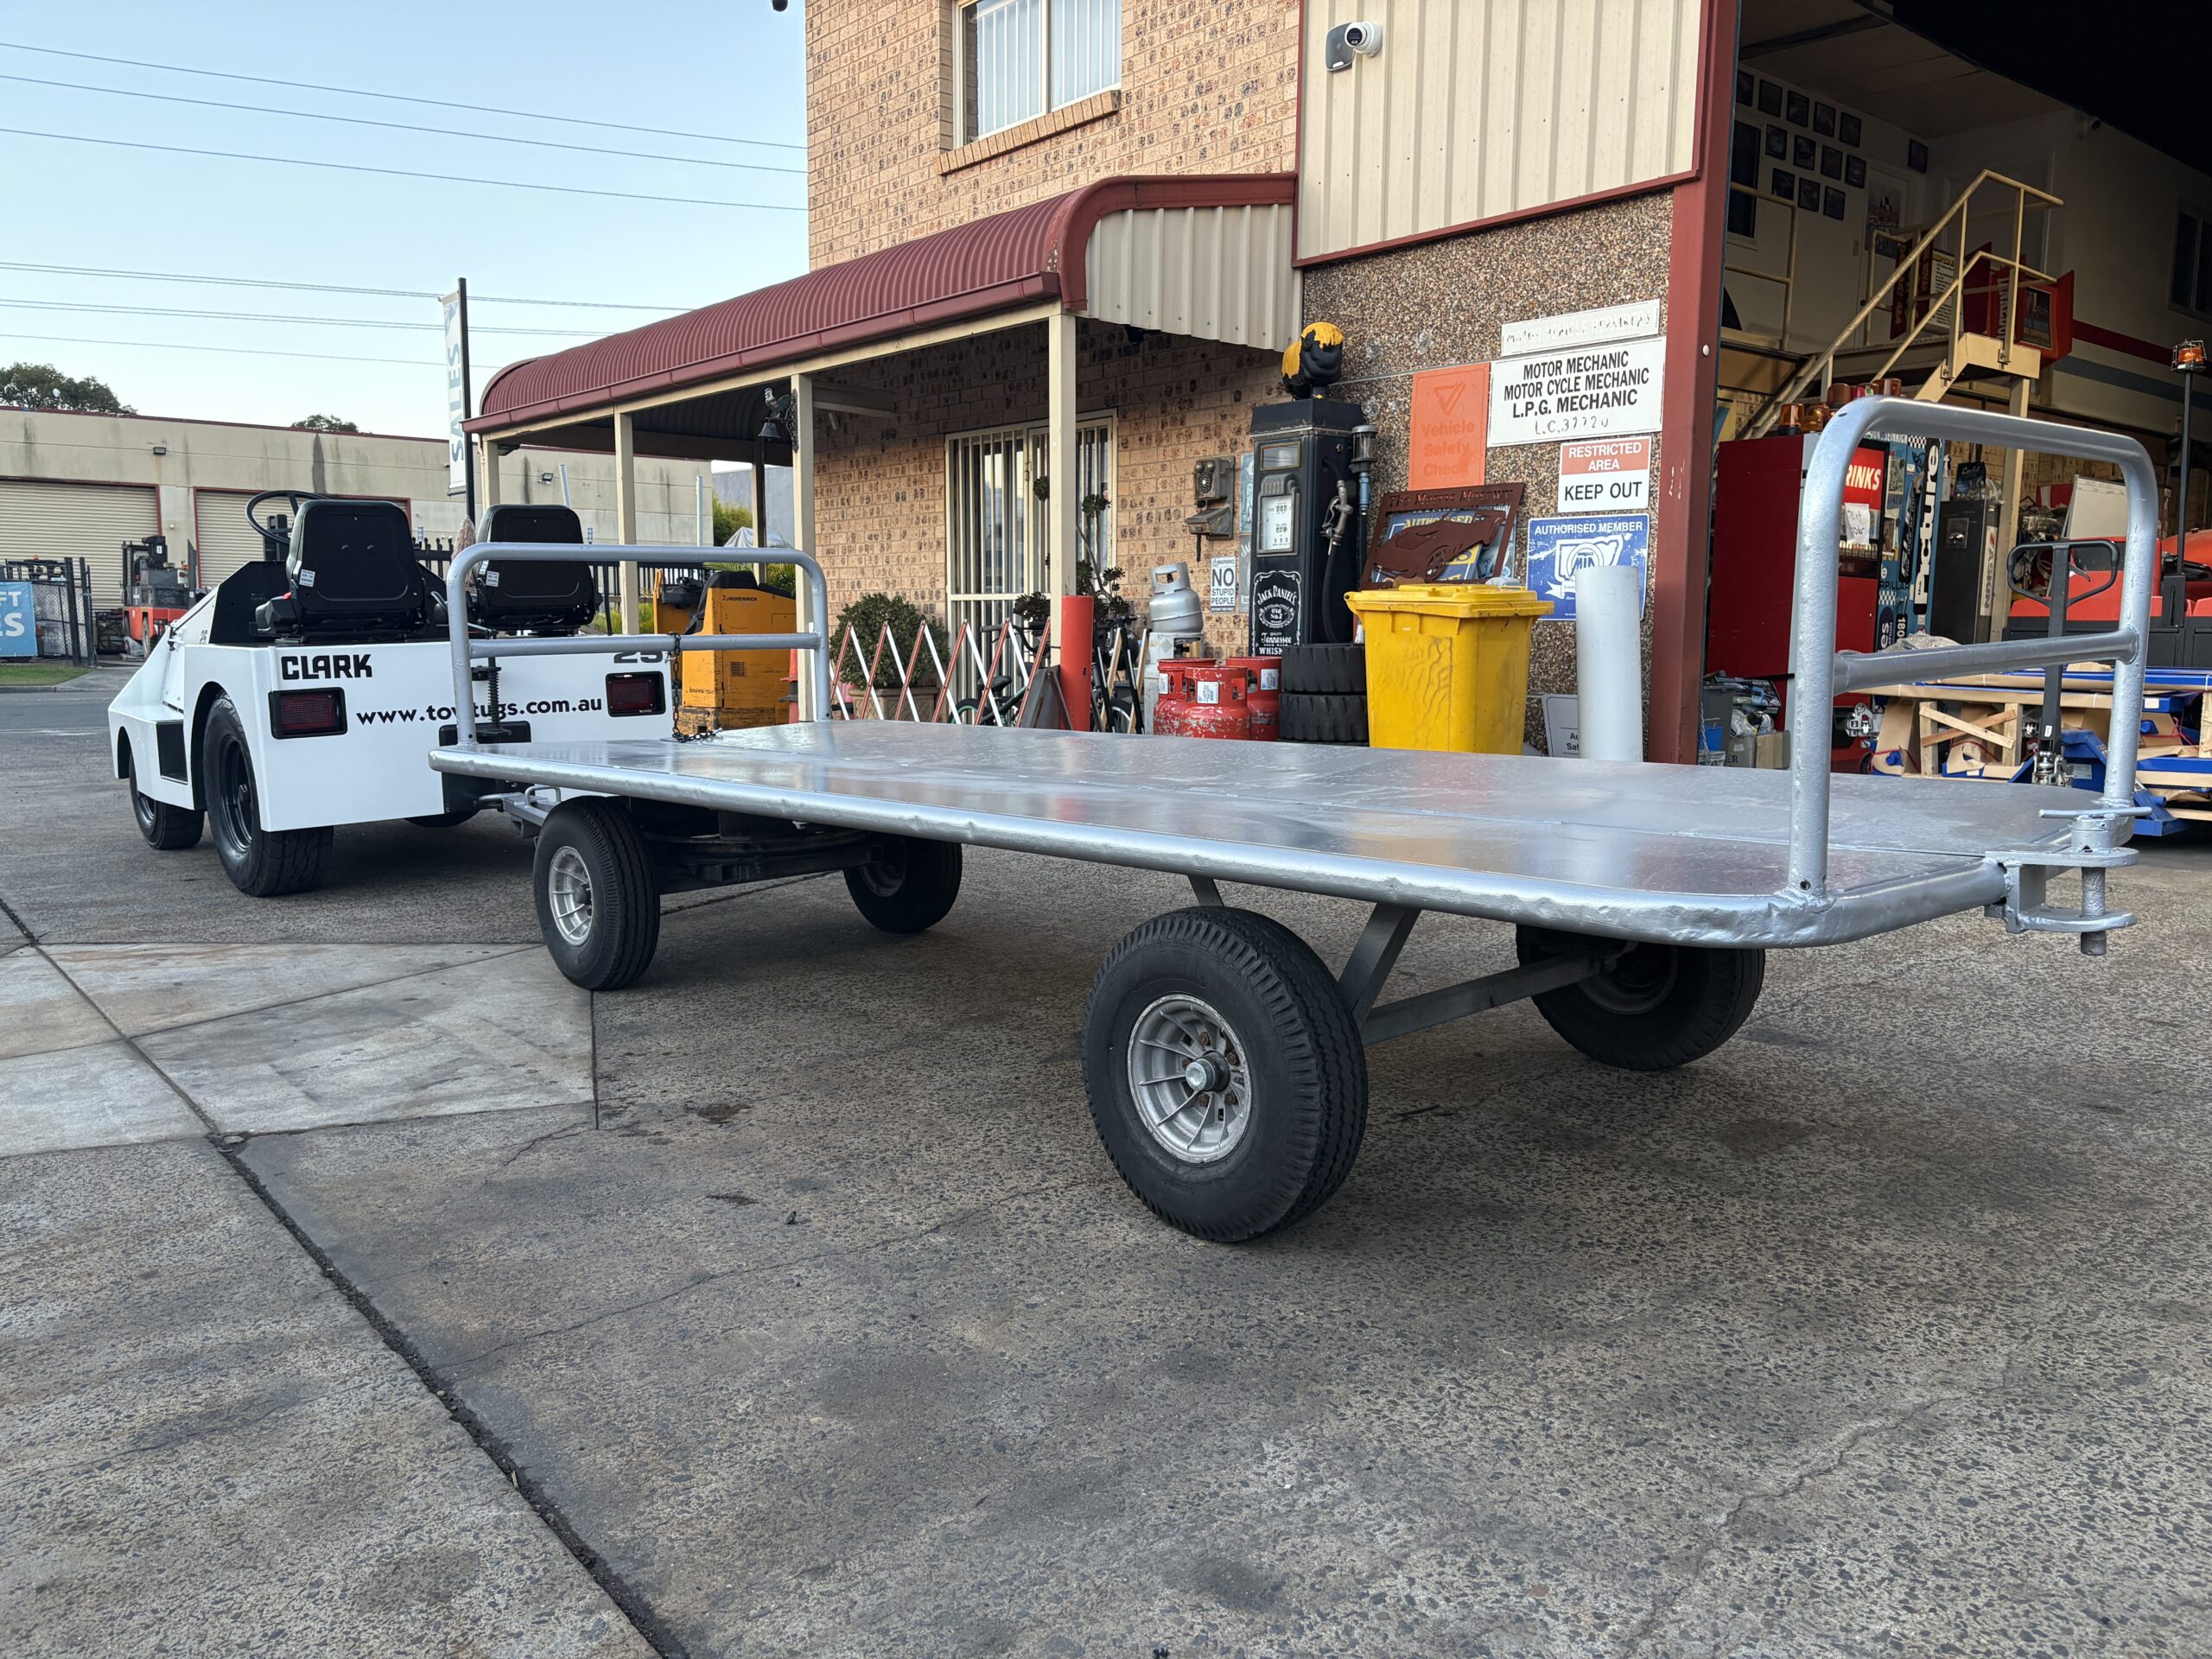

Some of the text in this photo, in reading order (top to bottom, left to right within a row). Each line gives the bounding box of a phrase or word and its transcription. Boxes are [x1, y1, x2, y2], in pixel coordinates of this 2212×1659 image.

[1523, 351, 1629, 380] MOTOR MECHANIC
[1504, 367, 1649, 401] MOTOR CYCLE MECHANIC
[447, 342, 464, 463] SALES
[1513, 389, 1637, 418] L.P.G. MECHANIC
[1421, 419, 1475, 437] Vehicle
[1423, 438, 1471, 458] Safety
[1568, 442, 1642, 458] RESTRICTED
[1423, 461, 1469, 477] Check
[1587, 458, 1620, 472] AREA
[1846, 464, 1882, 491] RINKS
[1564, 481, 1643, 501] KEEP OUT
[1535, 521, 1643, 535] AUTHORISED MEMBER
[1211, 568, 1234, 588] NO
[1880, 581, 1909, 590] RPILLAR
[0, 591, 22, 607] FT
[1211, 588, 1235, 596] STUPID
[1257, 588, 1273, 605] JACK
[1261, 632, 1292, 644] Tennessee
[281, 654, 372, 681] CLARK
[356, 696, 602, 726] www.totugs.com.au
